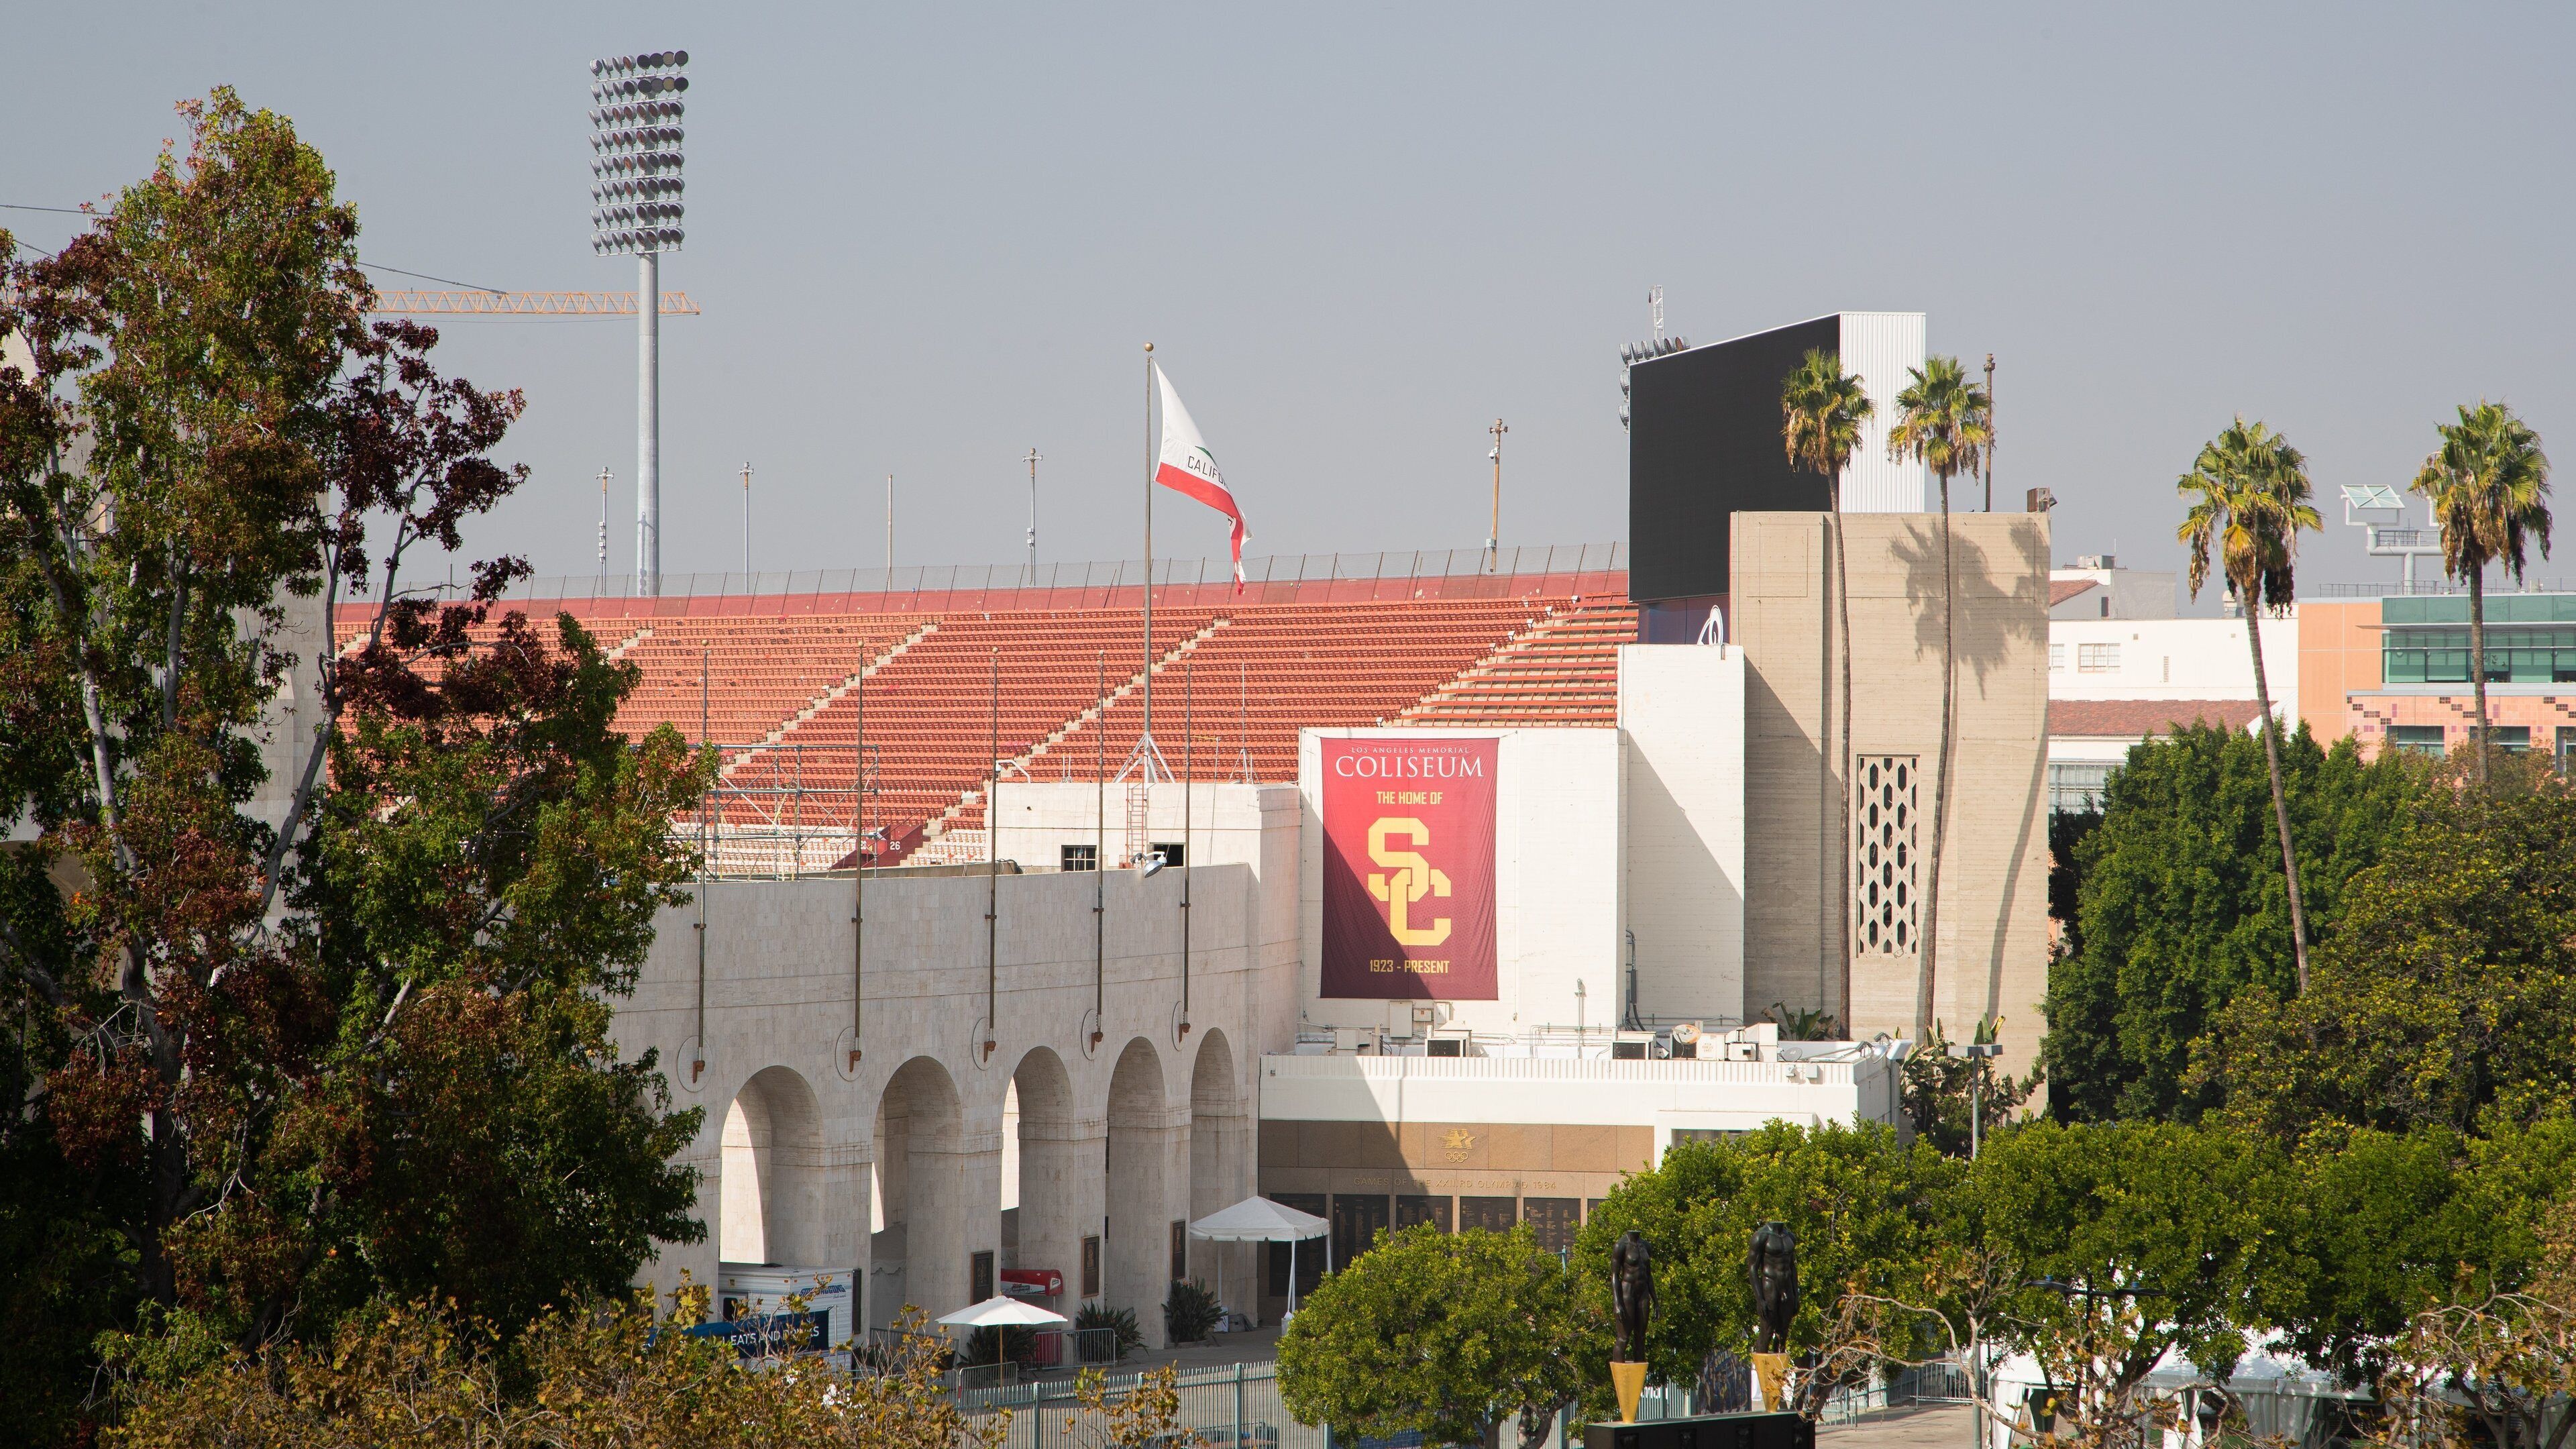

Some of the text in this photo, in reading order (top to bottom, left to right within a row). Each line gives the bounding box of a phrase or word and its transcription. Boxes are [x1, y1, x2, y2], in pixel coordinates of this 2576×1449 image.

[1336, 755, 1485, 777] COLISEUM
[1377, 791, 1443, 805] THE HOME OF
[890, 841, 900, 851] 26
[1368, 817, 1452, 946] SC
[1370, 959, 1393, 972] 1923
[1404, 960, 1450, 973] PRESENT
[1354, 1177, 1389, 1186] GAMES
[1394, 1177, 1407, 1187] OF
[1412, 1179, 1431, 1187] THE
[1478, 1180, 1529, 1189] OLYMPIAD
[1533, 1181, 1557, 1190] 1984
[731, 1332, 756, 1346] EATS
[758, 1331, 781, 1342] AND
[783, 1326, 820, 1340] DRS
